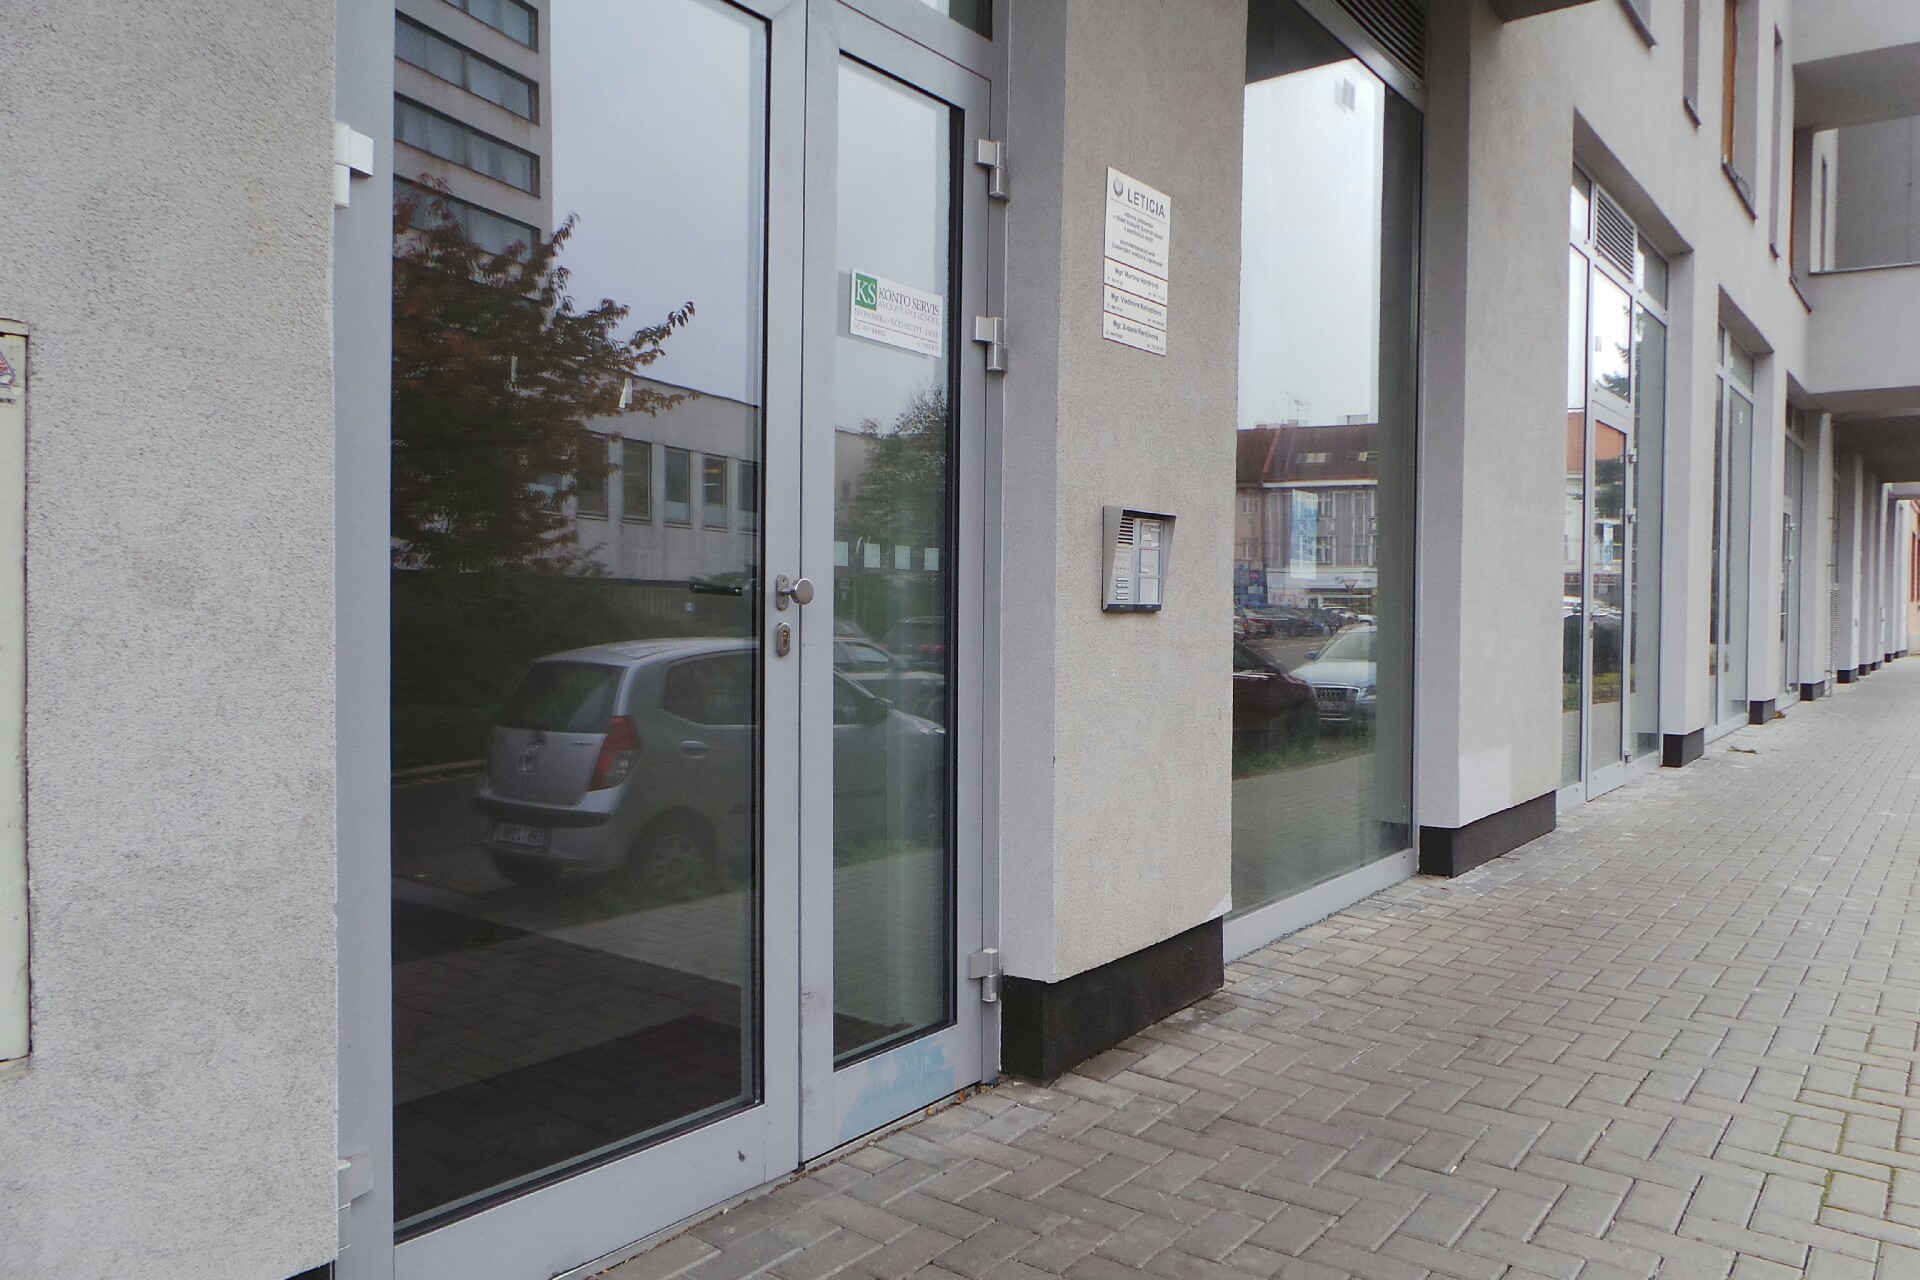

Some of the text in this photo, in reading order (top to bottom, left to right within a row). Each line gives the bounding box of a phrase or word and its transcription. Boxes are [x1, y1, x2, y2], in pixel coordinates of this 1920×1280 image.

[1127, 188, 1165, 219] LETICIA
[855, 279, 876, 305] KS
[878, 287, 940, 317] KONTO SERVIS
